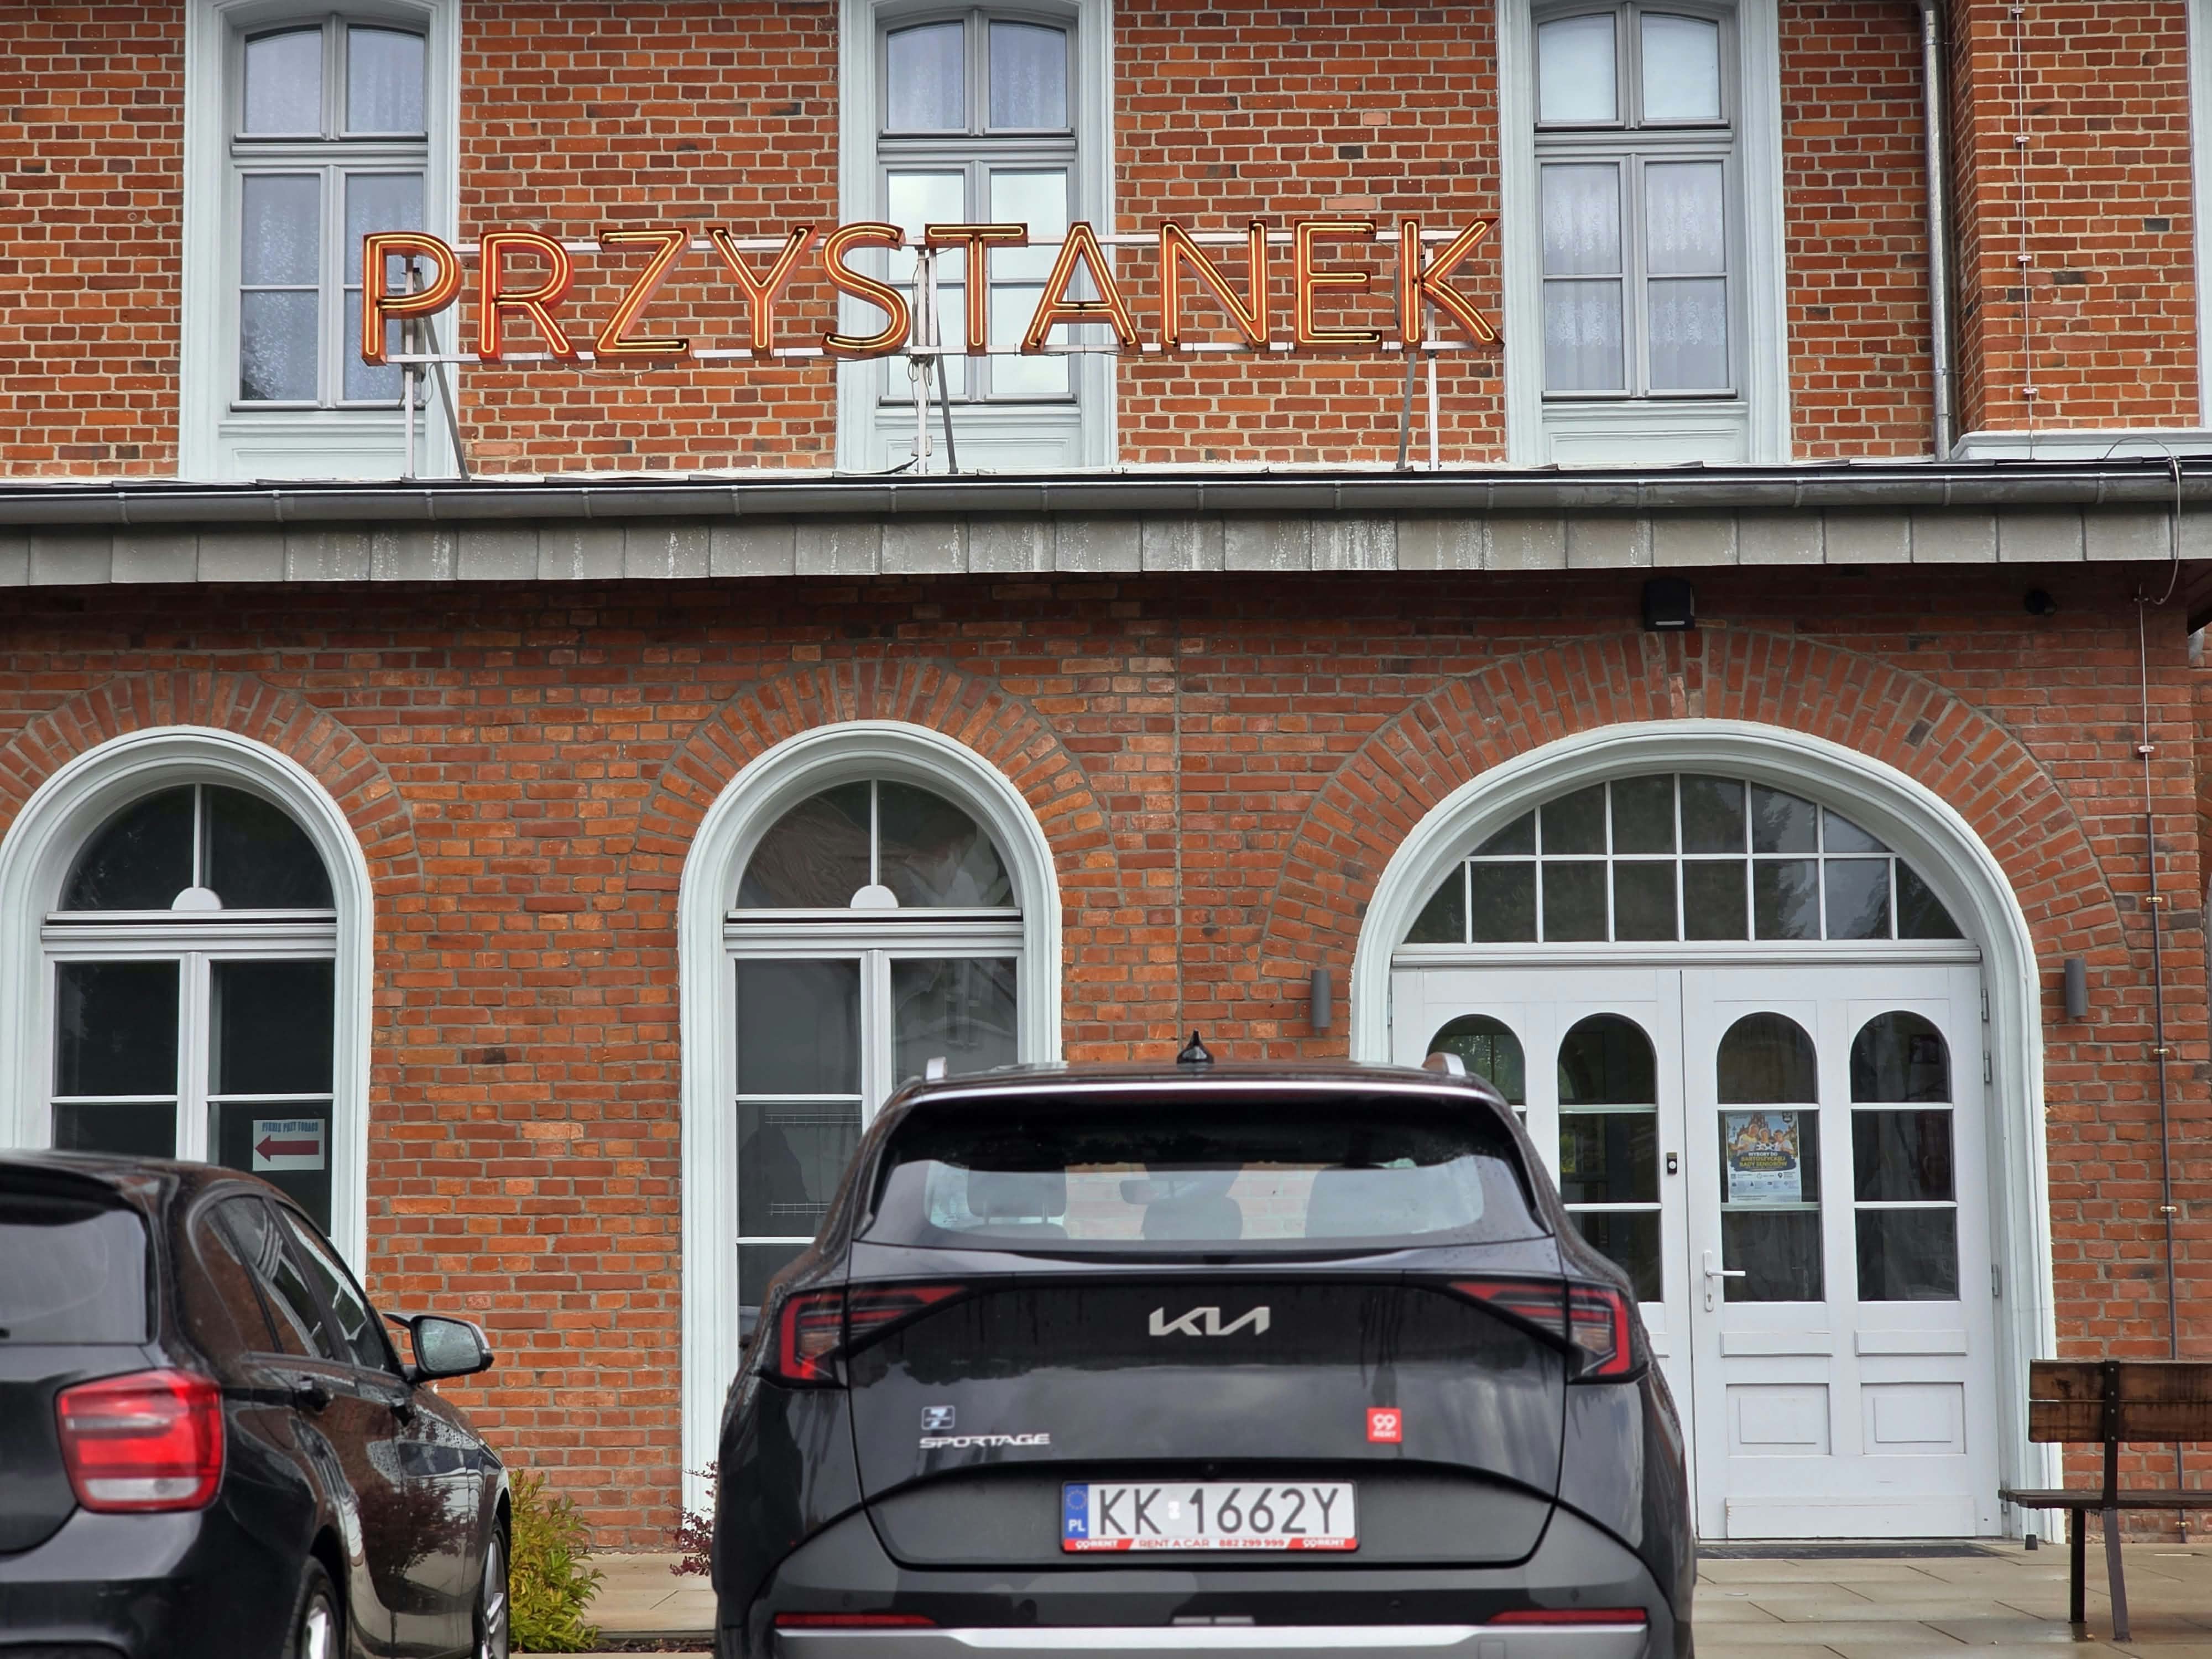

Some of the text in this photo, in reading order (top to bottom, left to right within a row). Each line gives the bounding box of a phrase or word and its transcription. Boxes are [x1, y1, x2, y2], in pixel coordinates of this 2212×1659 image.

[363, 217, 1504, 366] PRZYSTANEK
[1149, 1306, 1270, 1336] KIA
[1373, 1413, 1397, 1431] 99
[920, 1433, 1050, 1449] SPORTAGE
[1099, 1488, 1339, 1535] KK 1662Y
[1068, 1519, 1086, 1532] PL
[1139, 1539, 1211, 1548] RENT A CAR
[1218, 1539, 1285, 1547] 882 299 999
